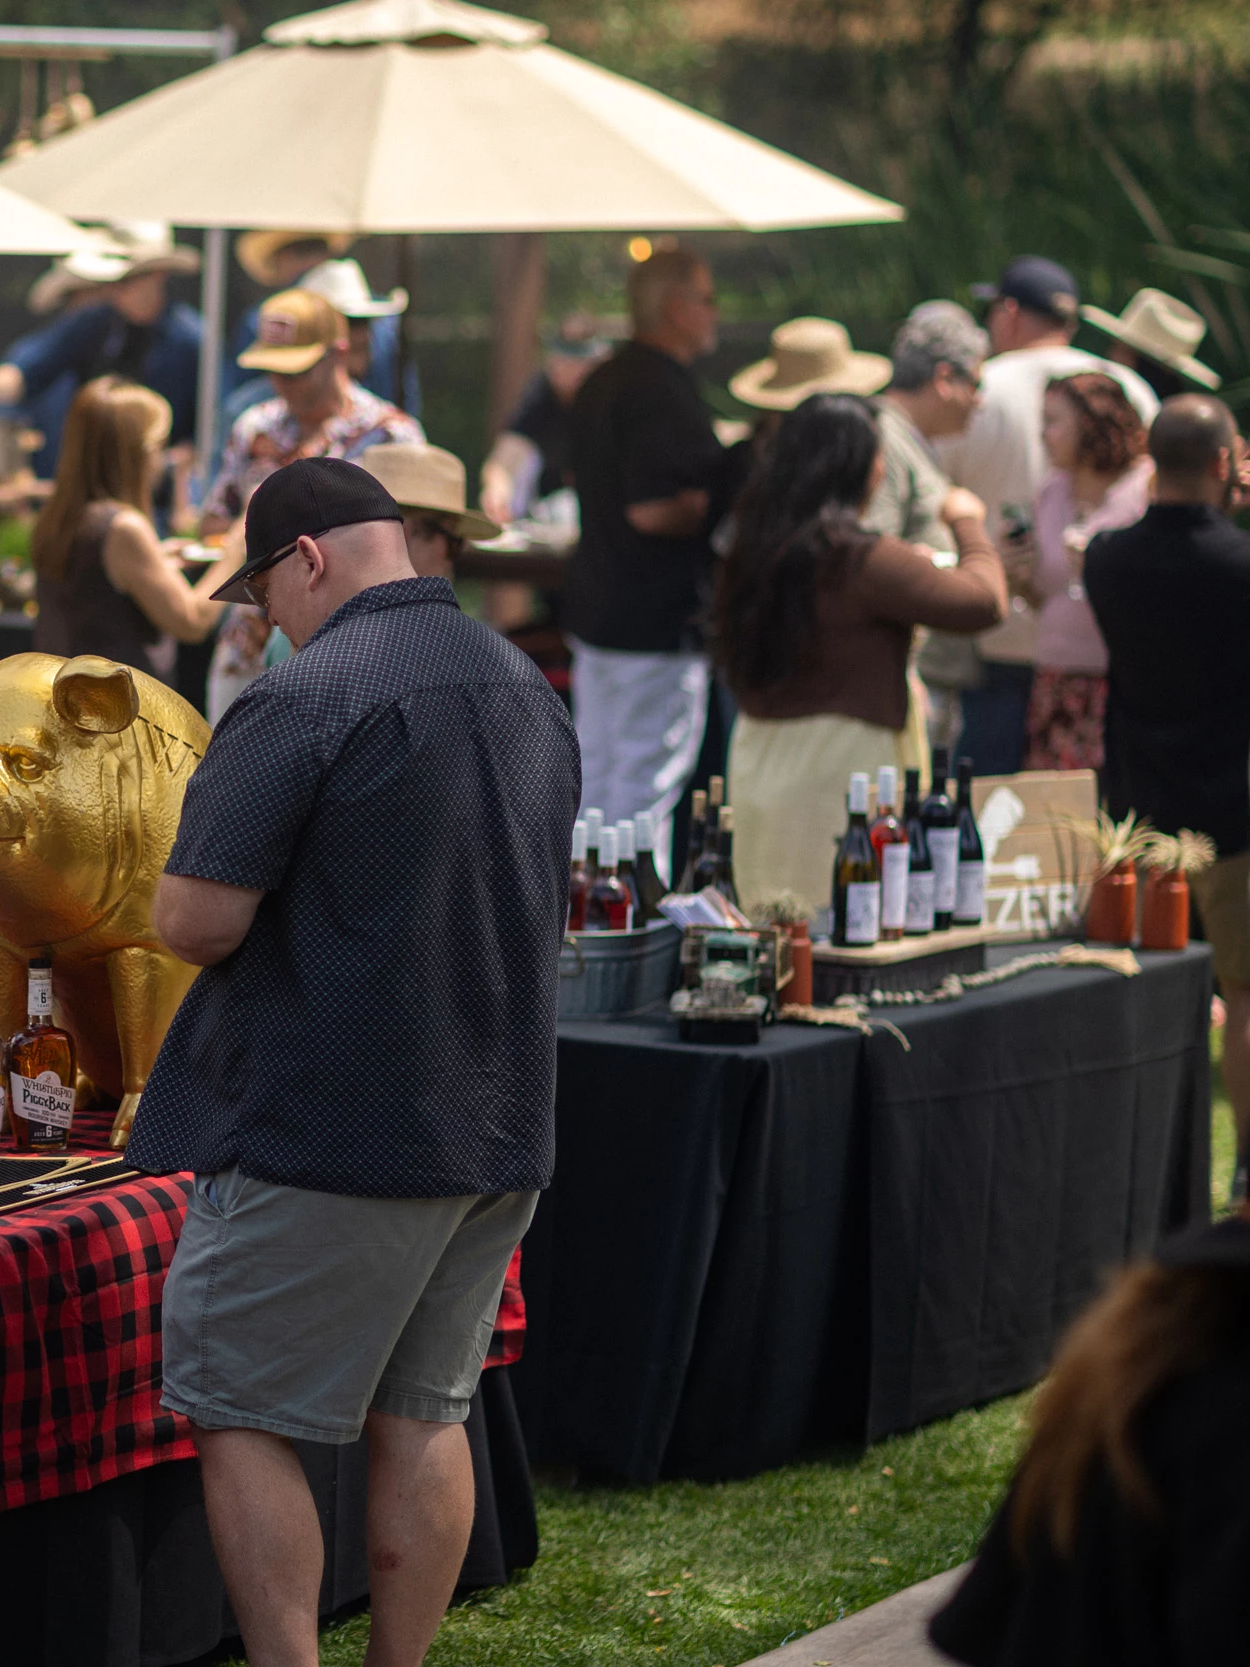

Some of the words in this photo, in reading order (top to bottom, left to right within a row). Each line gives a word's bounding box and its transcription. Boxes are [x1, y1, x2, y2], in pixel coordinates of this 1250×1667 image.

[41, 992, 47, 1004] 6
[21, 1078, 73, 1099] WHISTLEPIG
[22, 1088, 71, 1112] PIGGYBACK
[45, 1125, 53, 1138] 6
